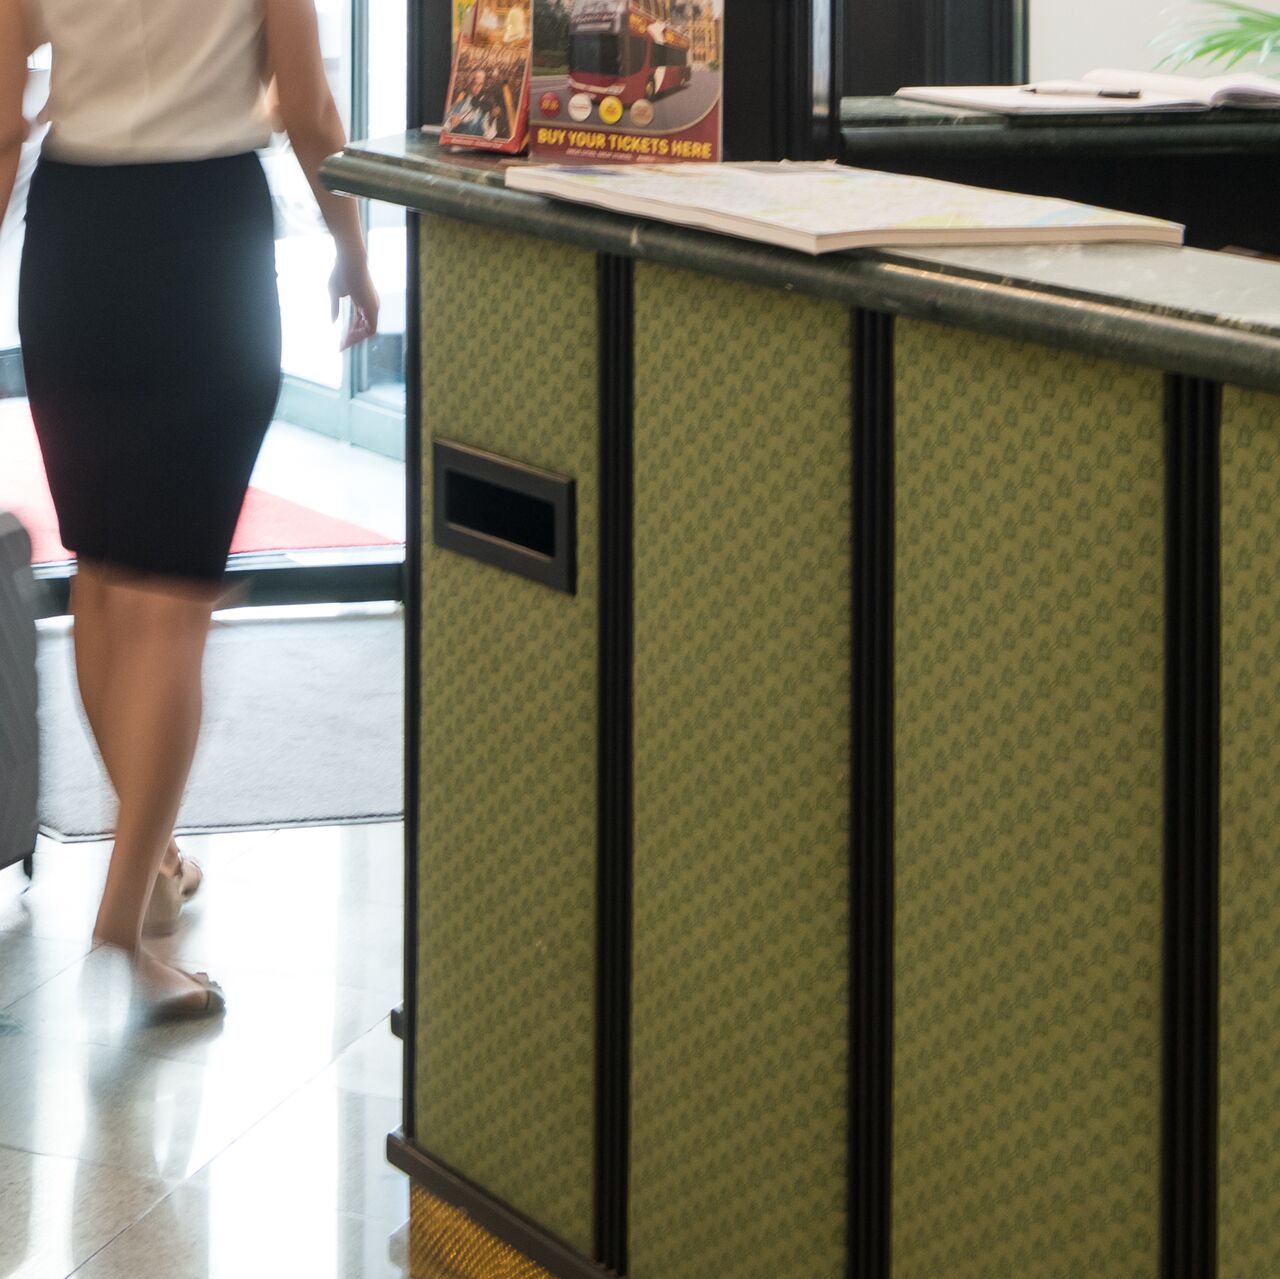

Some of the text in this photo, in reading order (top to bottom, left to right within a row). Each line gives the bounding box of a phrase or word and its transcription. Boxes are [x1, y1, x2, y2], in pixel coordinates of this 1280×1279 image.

[537, 128, 566, 145] BUY
[568, 130, 606, 149] YOUR
[607, 134, 669, 155] TICKETS
[671, 140, 712, 159] HERE
